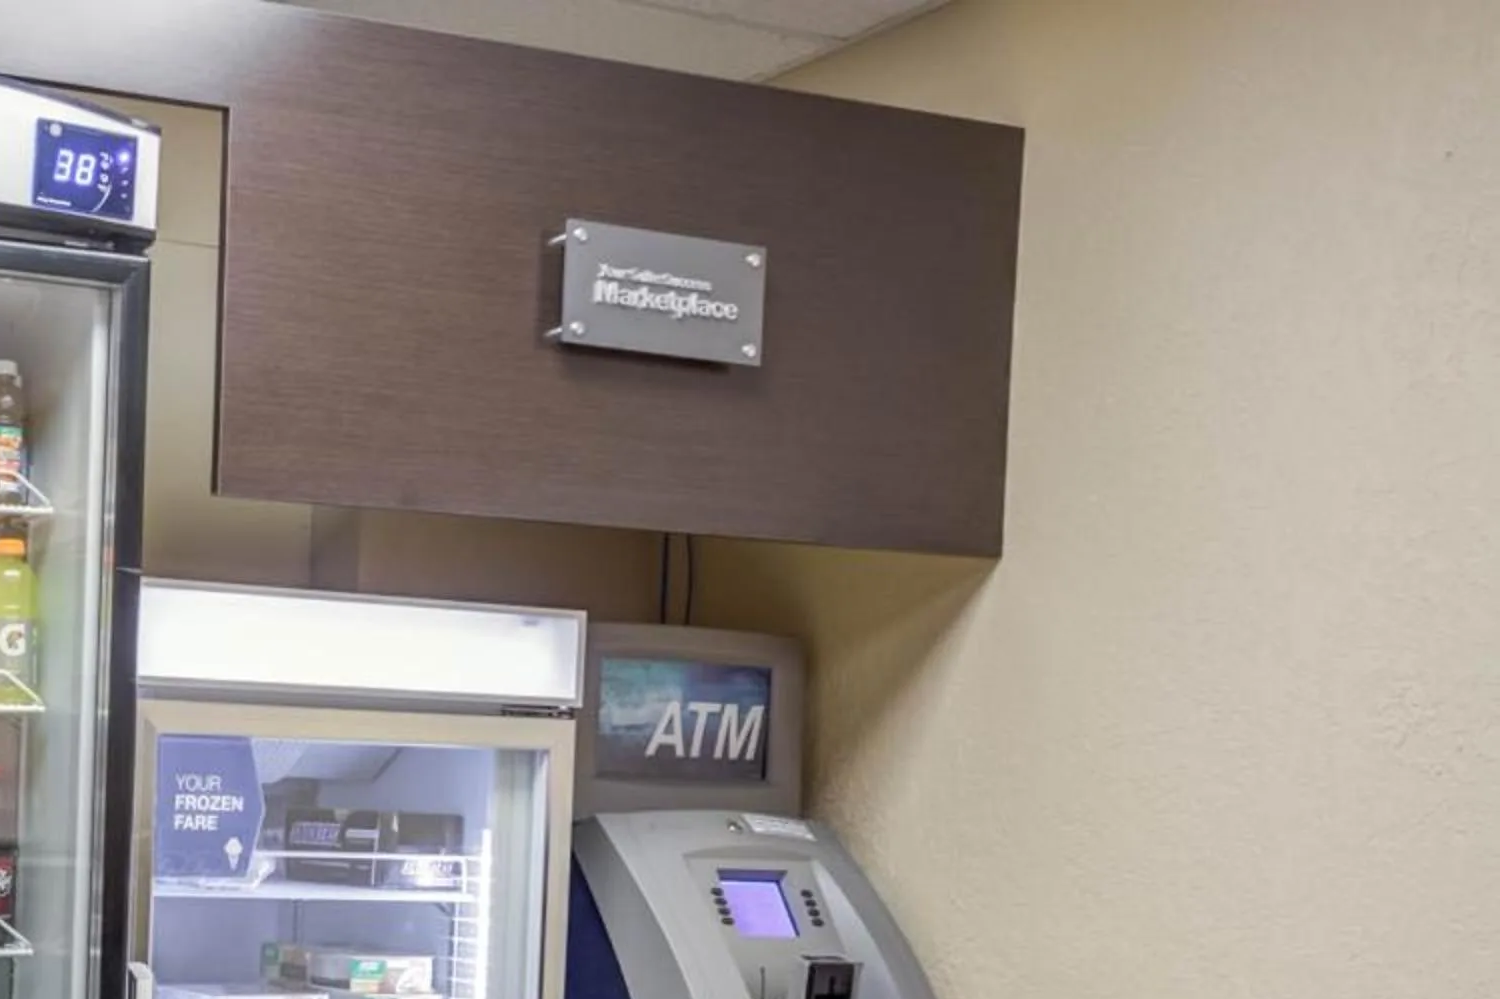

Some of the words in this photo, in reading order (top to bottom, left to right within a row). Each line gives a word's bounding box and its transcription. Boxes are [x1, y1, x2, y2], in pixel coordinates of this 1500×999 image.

[54, 149, 96, 185] 38
[593, 279, 738, 320] Marketplace
[644, 701, 765, 761] ATM
[175, 774, 222, 791] YOUR
[174, 794, 244, 812] FROZEN
[174, 815, 219, 831] FARE
